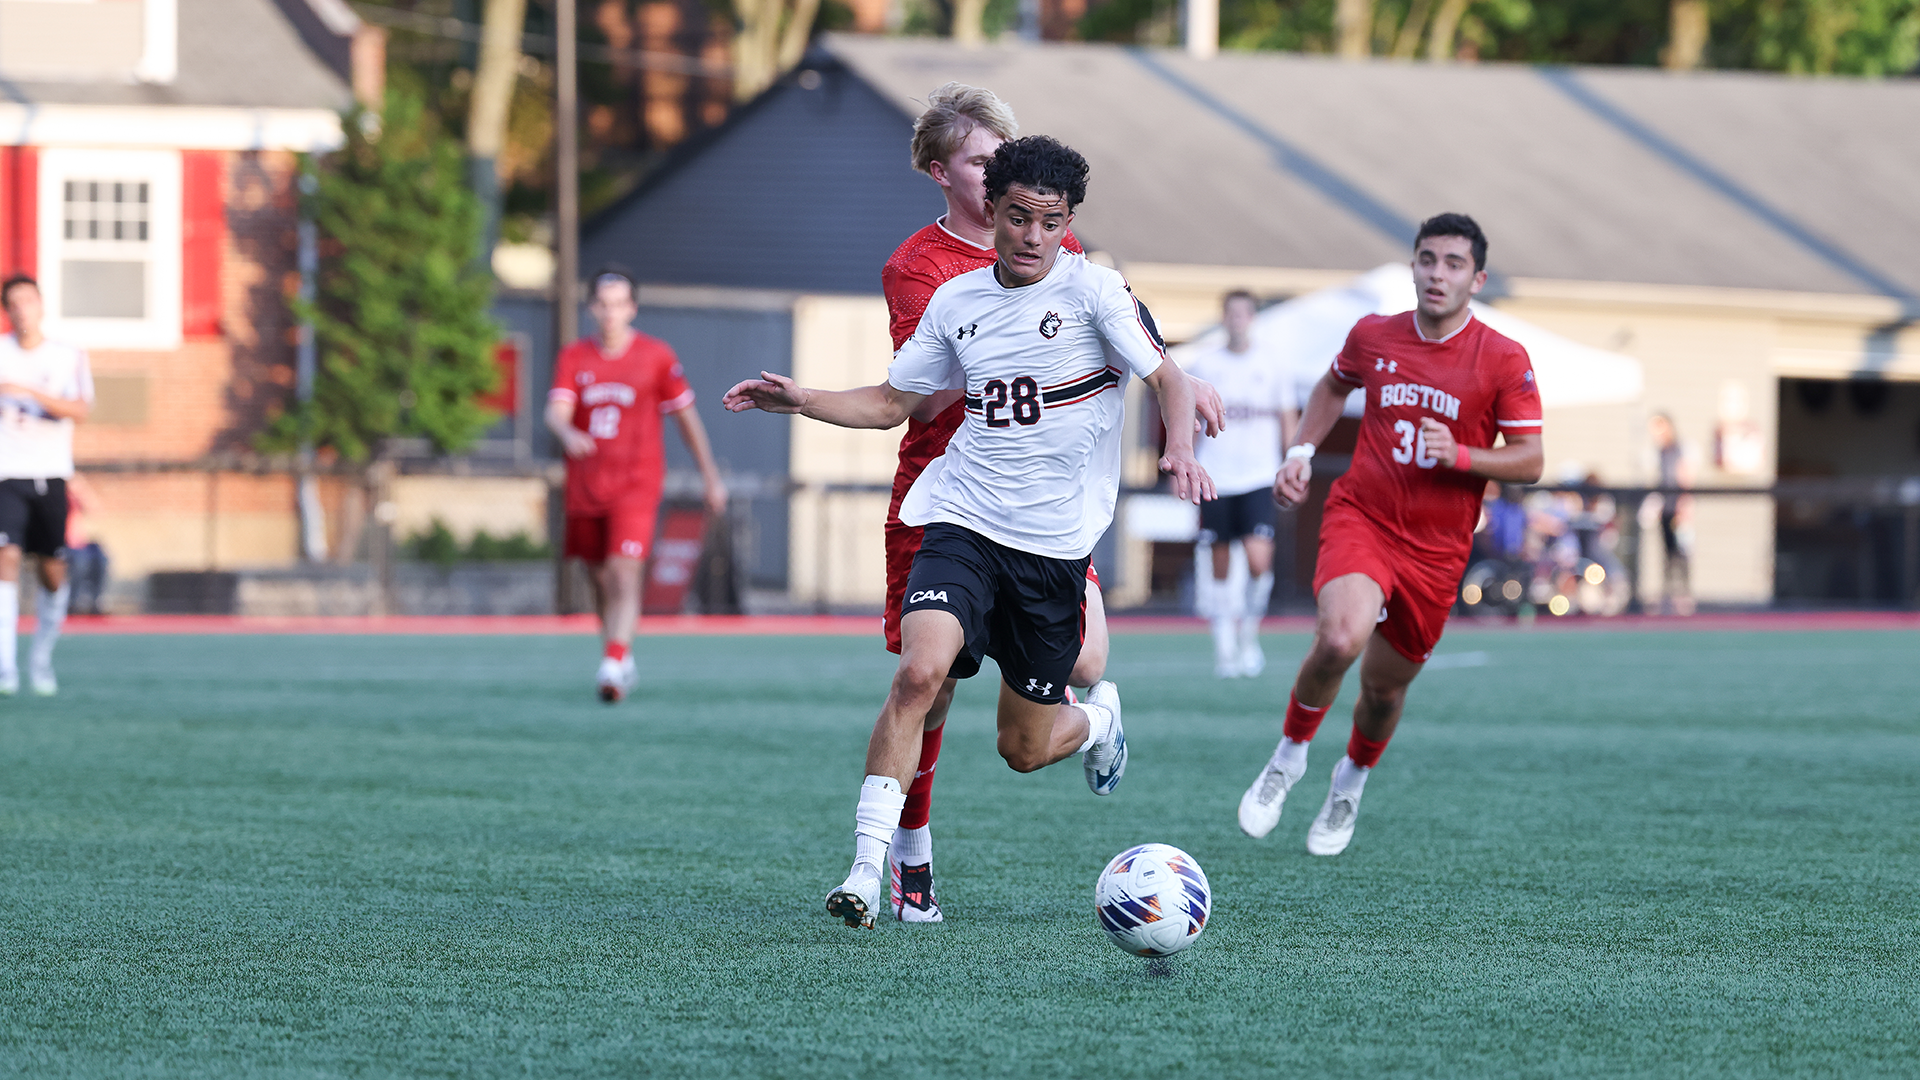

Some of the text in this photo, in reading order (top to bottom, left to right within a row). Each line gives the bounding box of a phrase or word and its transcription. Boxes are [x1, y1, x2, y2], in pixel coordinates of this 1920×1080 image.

[985, 376, 1041, 428] 28
[1380, 383, 1461, 421] BOSTON
[909, 589, 949, 604] CAA
